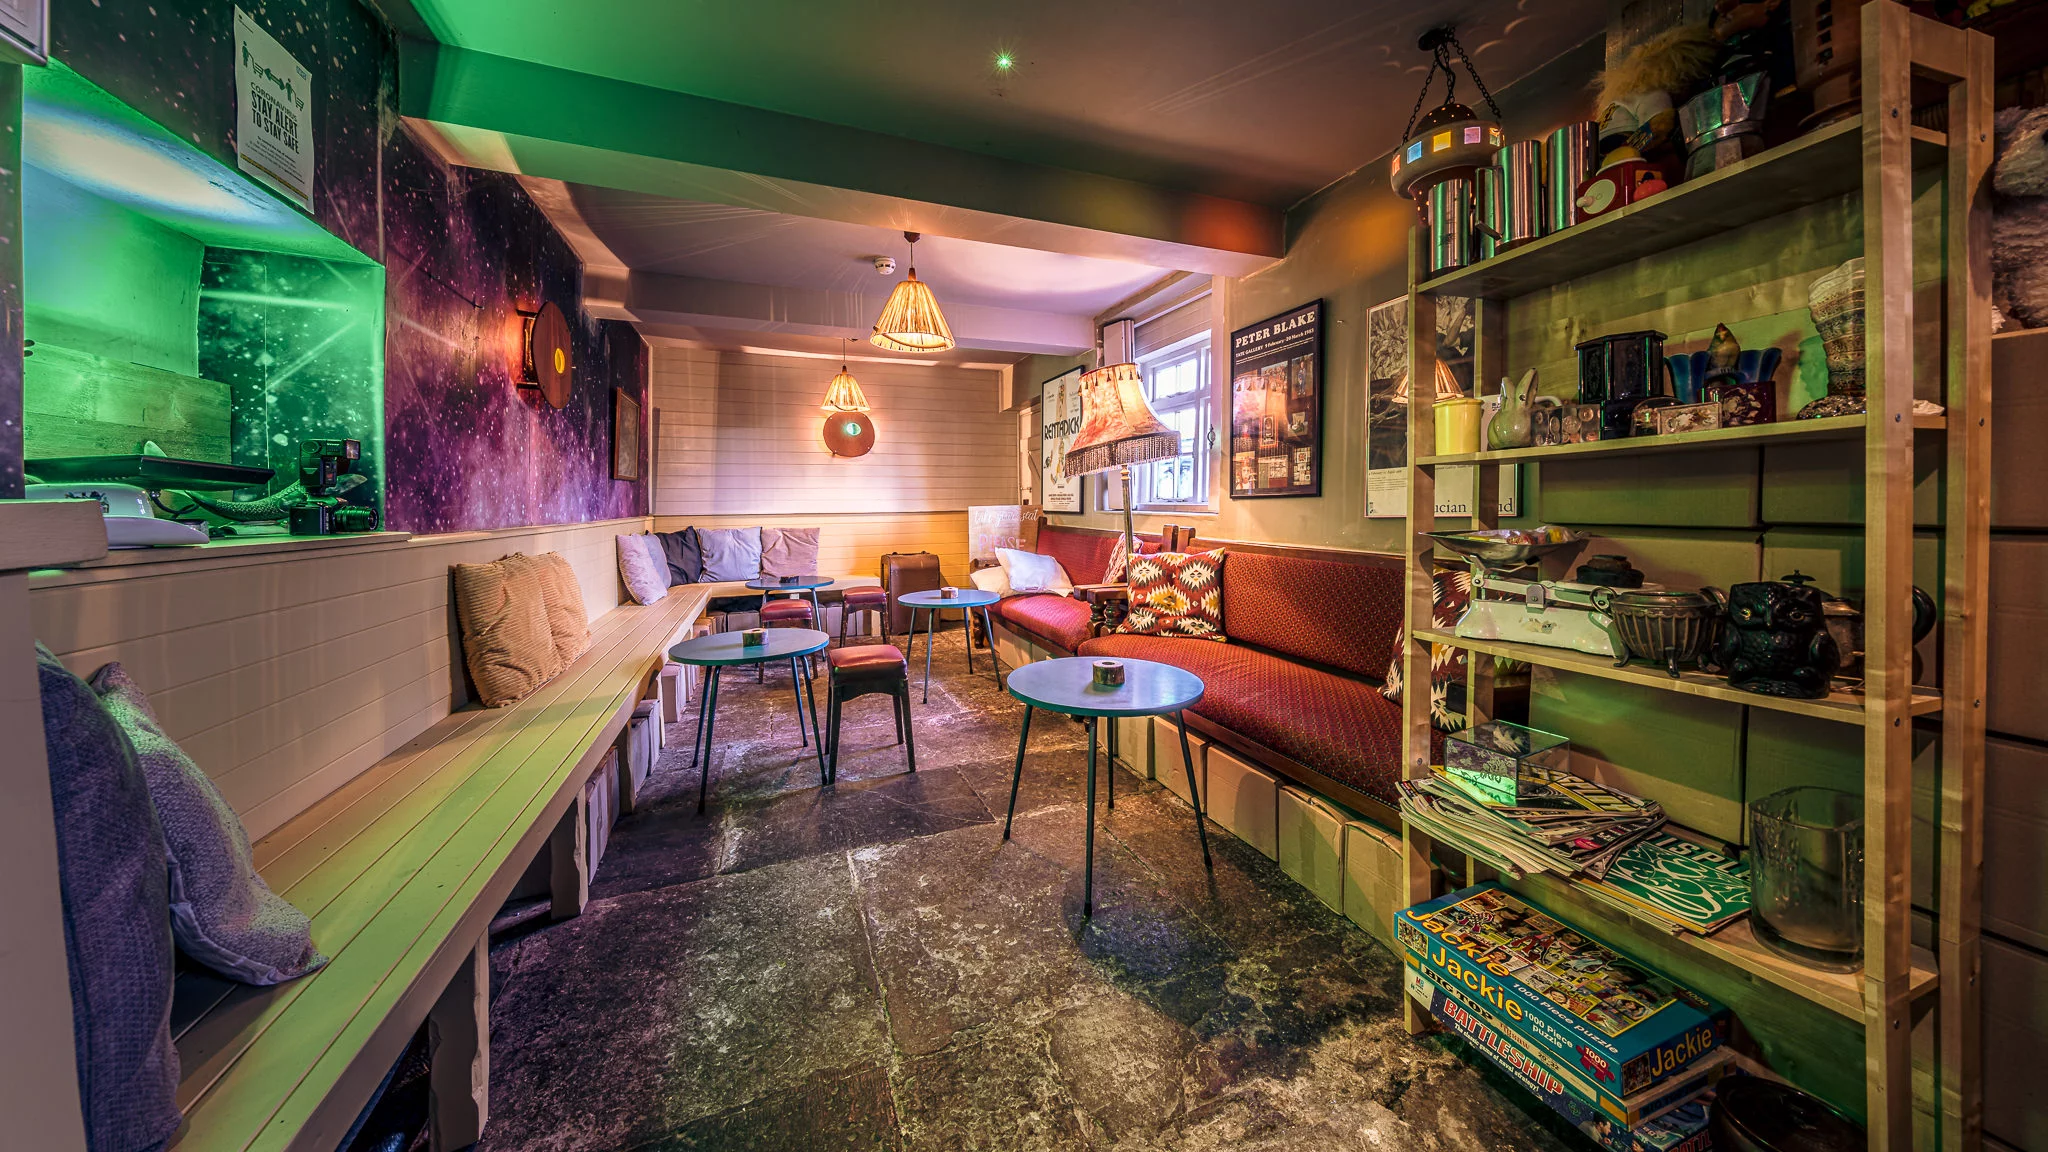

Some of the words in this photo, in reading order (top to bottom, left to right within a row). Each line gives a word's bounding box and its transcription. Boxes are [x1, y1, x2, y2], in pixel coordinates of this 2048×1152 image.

[250, 82, 297, 122] CORONAVIRUS
[251, 90, 274, 116] STAY
[273, 102, 298, 138] ALERT
[251, 108, 263, 128] TO
[263, 117, 282, 141] STAY
[283, 127, 299, 154] SAFE
[1235, 328, 1270, 348] PETER
[1273, 311, 1316, 335] BLAKE
[1245, 345, 1264, 355] GALLERY
[1044, 416, 1080, 440] RENTADICK
[1020, 508, 1039, 521] seat
[1435, 500, 1467, 513] cian
[979, 534, 1026, 552] PLEASE
[1406, 910, 1511, 977] Jackie
[1425, 966, 1454, 992] BIG
[1455, 992, 1494, 1021] TOP
[1431, 947, 1523, 1021] Jackie
[1687, 990, 1710, 1006] 1000
[1513, 983, 1540, 1001] 1000
[1540, 1001, 1574, 1024] Piece
[1573, 1025, 1619, 1053] puzzle
[1524, 1010, 1545, 1028] 1000
[1547, 1025, 1573, 1048] Piece
[1532, 1025, 1563, 1049] puzzle
[1443, 997, 1565, 1095] BATTLESHIP
[1454, 1023, 1464, 1034] The
[1463, 1032, 1480, 1046] classic
[1479, 1044, 1493, 1057] game
[1499, 1060, 1515, 1073] naval
[1514, 1071, 1540, 1093] strategy!
[1585, 1047, 1607, 1068] 1000
[1651, 1027, 1712, 1077] Jackie
